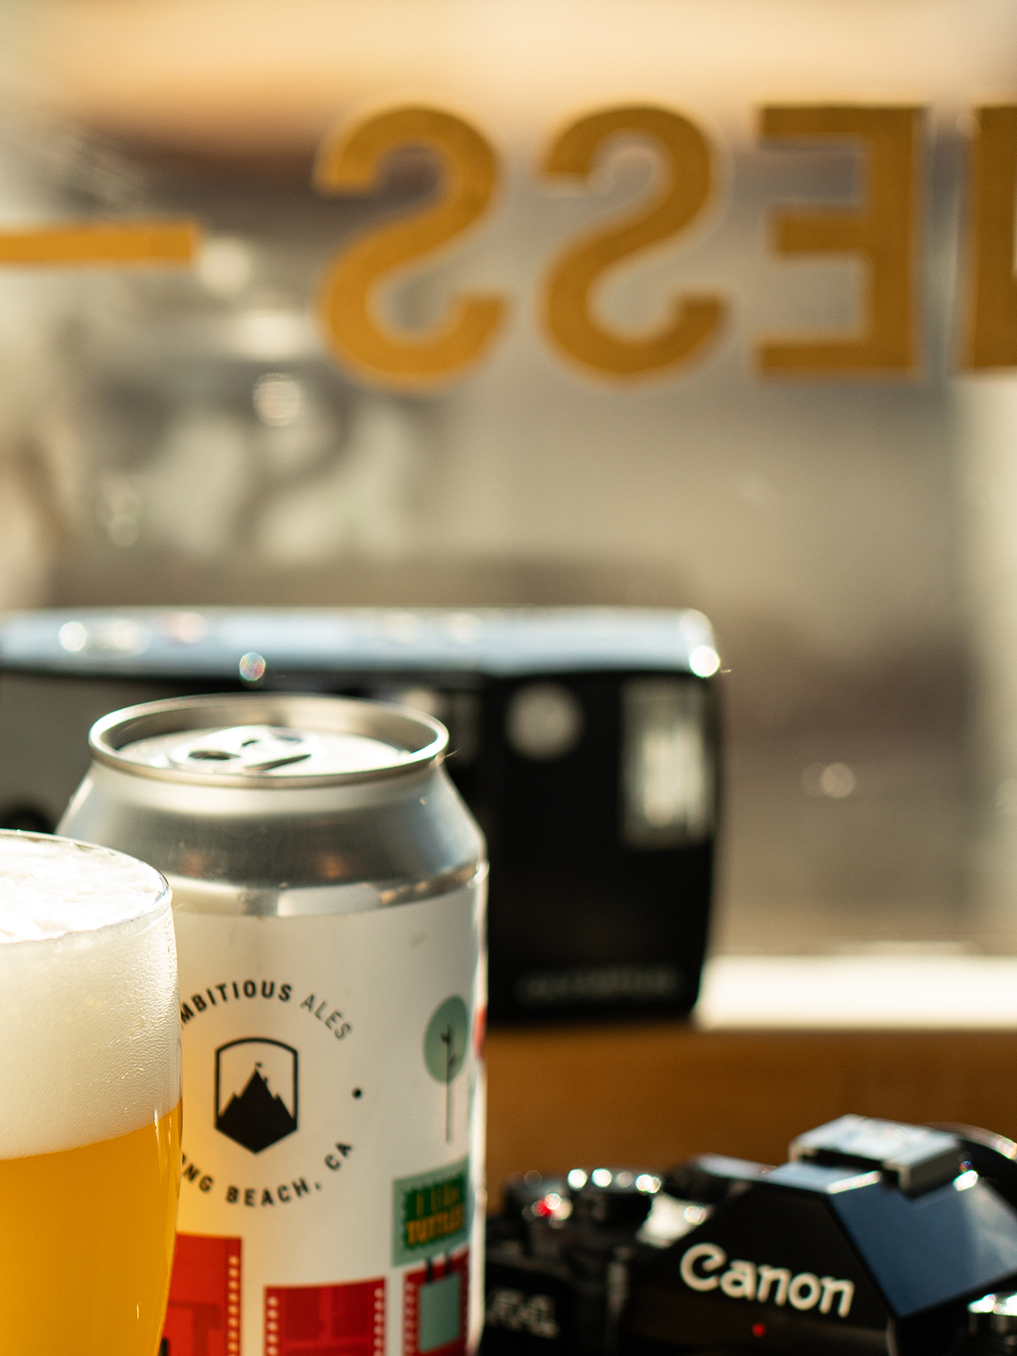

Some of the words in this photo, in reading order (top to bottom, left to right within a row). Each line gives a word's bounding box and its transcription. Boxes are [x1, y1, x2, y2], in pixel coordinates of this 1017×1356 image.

[180, 980, 293, 1030] MBITIOUS
[300, 993, 353, 1041] ALES
[324, 1140, 354, 1172] CA
[679, 1242, 855, 1318] Canon
